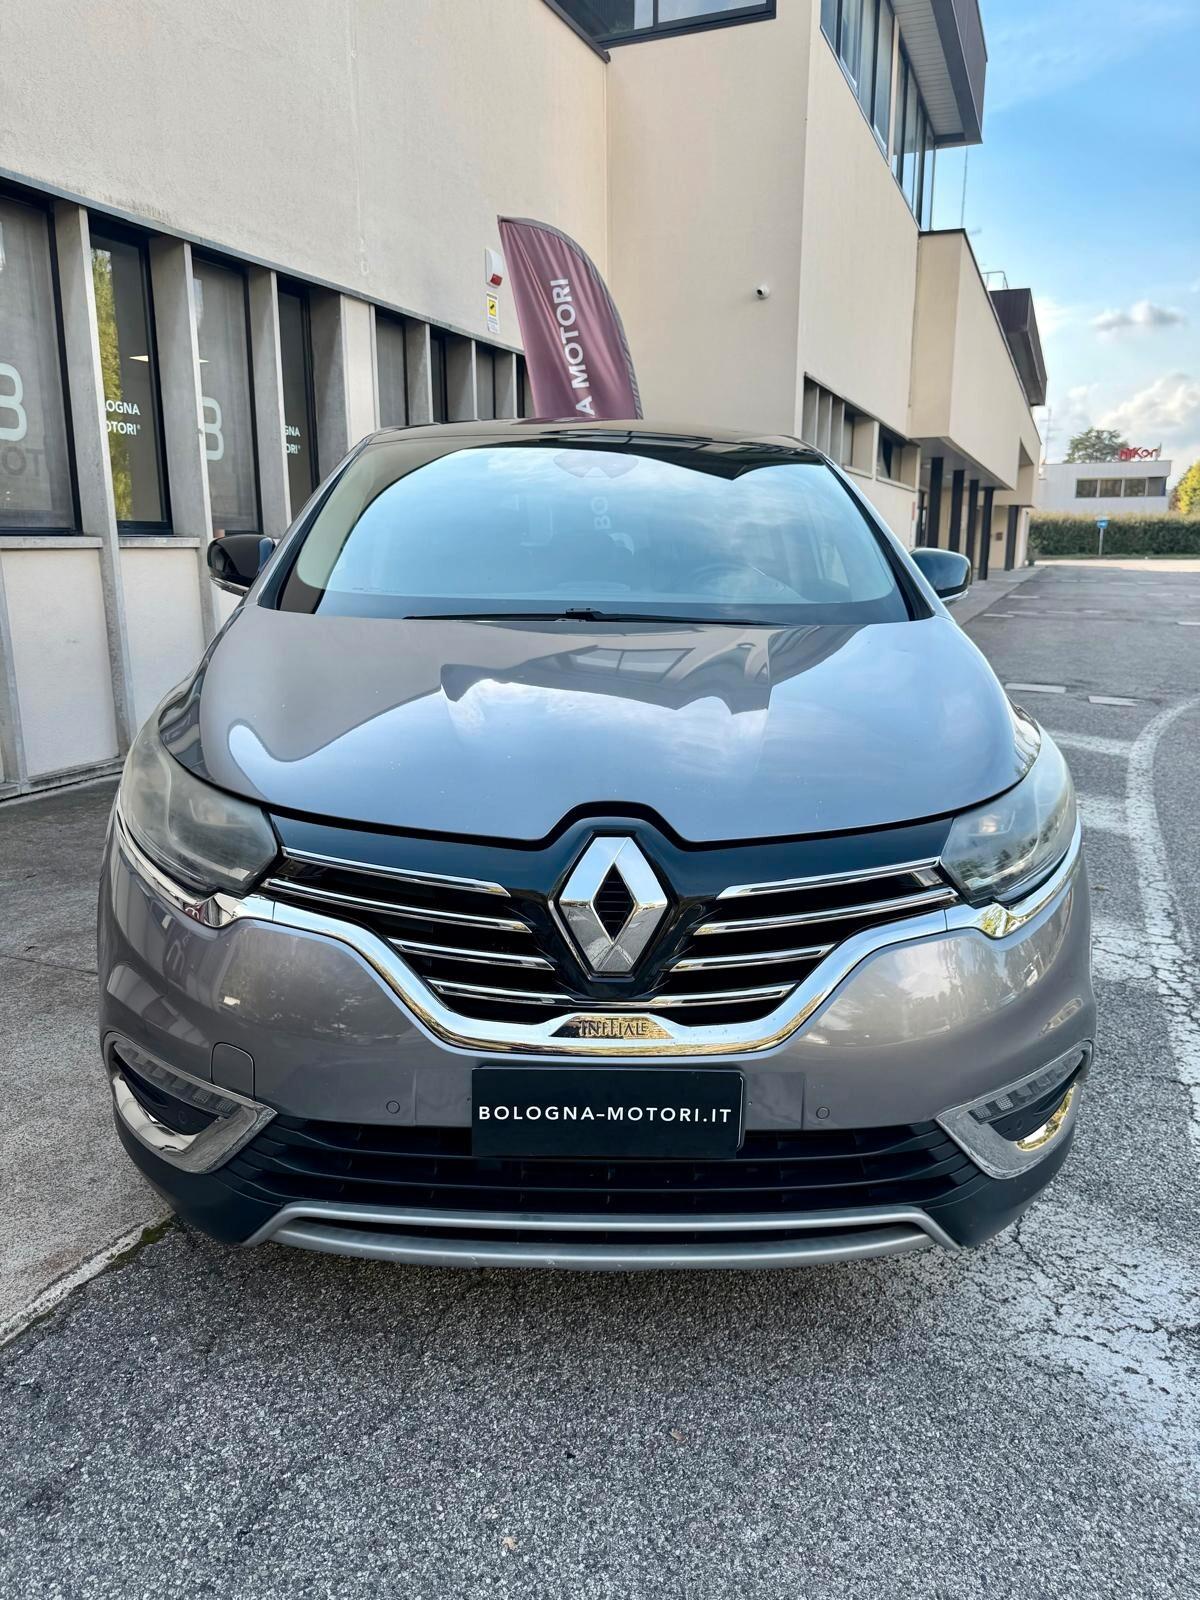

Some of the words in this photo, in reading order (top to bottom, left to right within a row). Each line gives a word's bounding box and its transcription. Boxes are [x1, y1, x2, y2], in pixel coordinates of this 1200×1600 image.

[550, 278, 590, 389] MOTORI
[104, 400, 141, 416] OGNA
[105, 420, 140, 436] OTORI
[579, 1017, 649, 1037] INITIALE
[478, 1105, 733, 1124] BOLOGNA-MOTORI.IT
